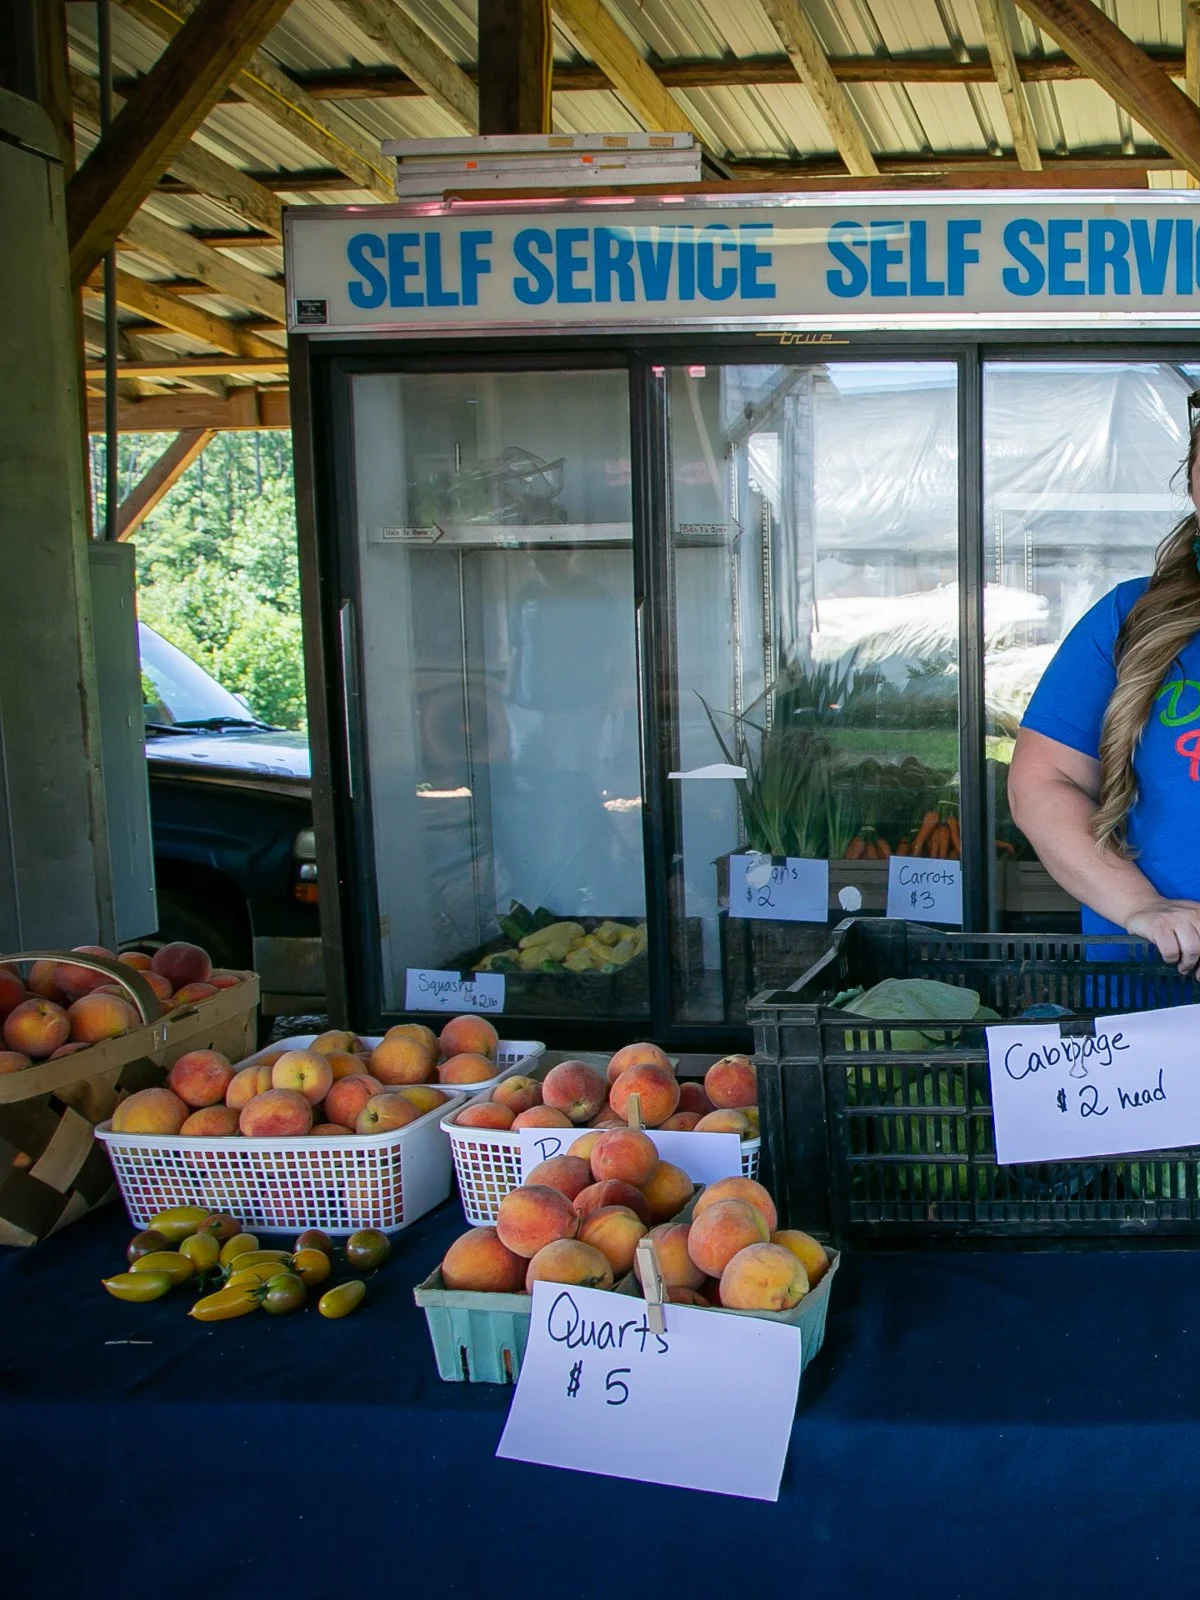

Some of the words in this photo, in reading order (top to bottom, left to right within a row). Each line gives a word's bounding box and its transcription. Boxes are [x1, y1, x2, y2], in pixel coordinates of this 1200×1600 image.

[347, 230, 493, 310] SELF
[513, 223, 777, 306] SERVICE
[826, 219, 982, 299] SELF
[756, 331, 850, 345] true
[899, 864, 955, 887] Carrots
[910, 889, 936, 909] $3
[1004, 1031, 1131, 1080] Cabbage
[1117, 1067, 1167, 1110] head
[547, 1291, 670, 1354] Quarts
